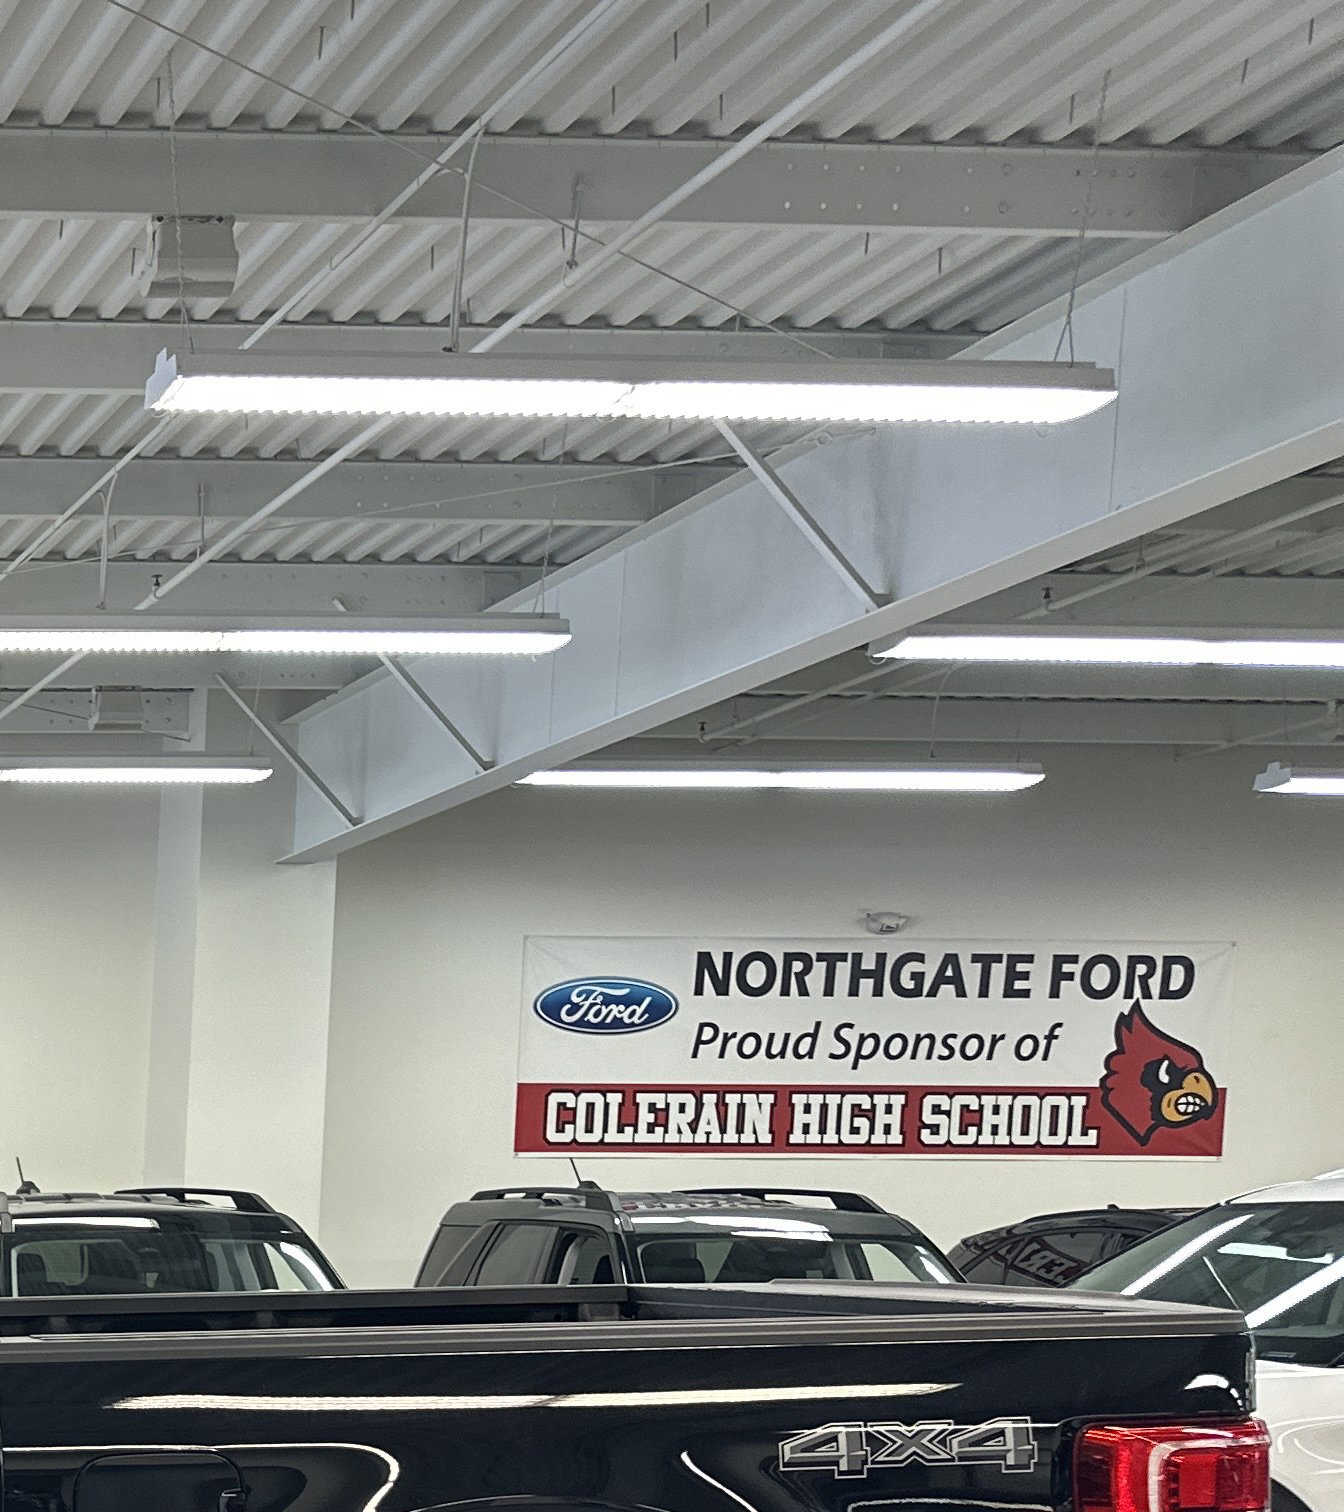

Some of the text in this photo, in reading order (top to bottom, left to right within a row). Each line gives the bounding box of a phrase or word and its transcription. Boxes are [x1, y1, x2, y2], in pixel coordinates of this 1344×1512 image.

[692, 951, 1196, 1002] NORTHGATE FORD
[561, 986, 650, 1027] Ford
[691, 1021, 1064, 1070] Proud Sponsor of
[544, 1091, 1099, 1148] COLERAIN HIGH SCHOOL
